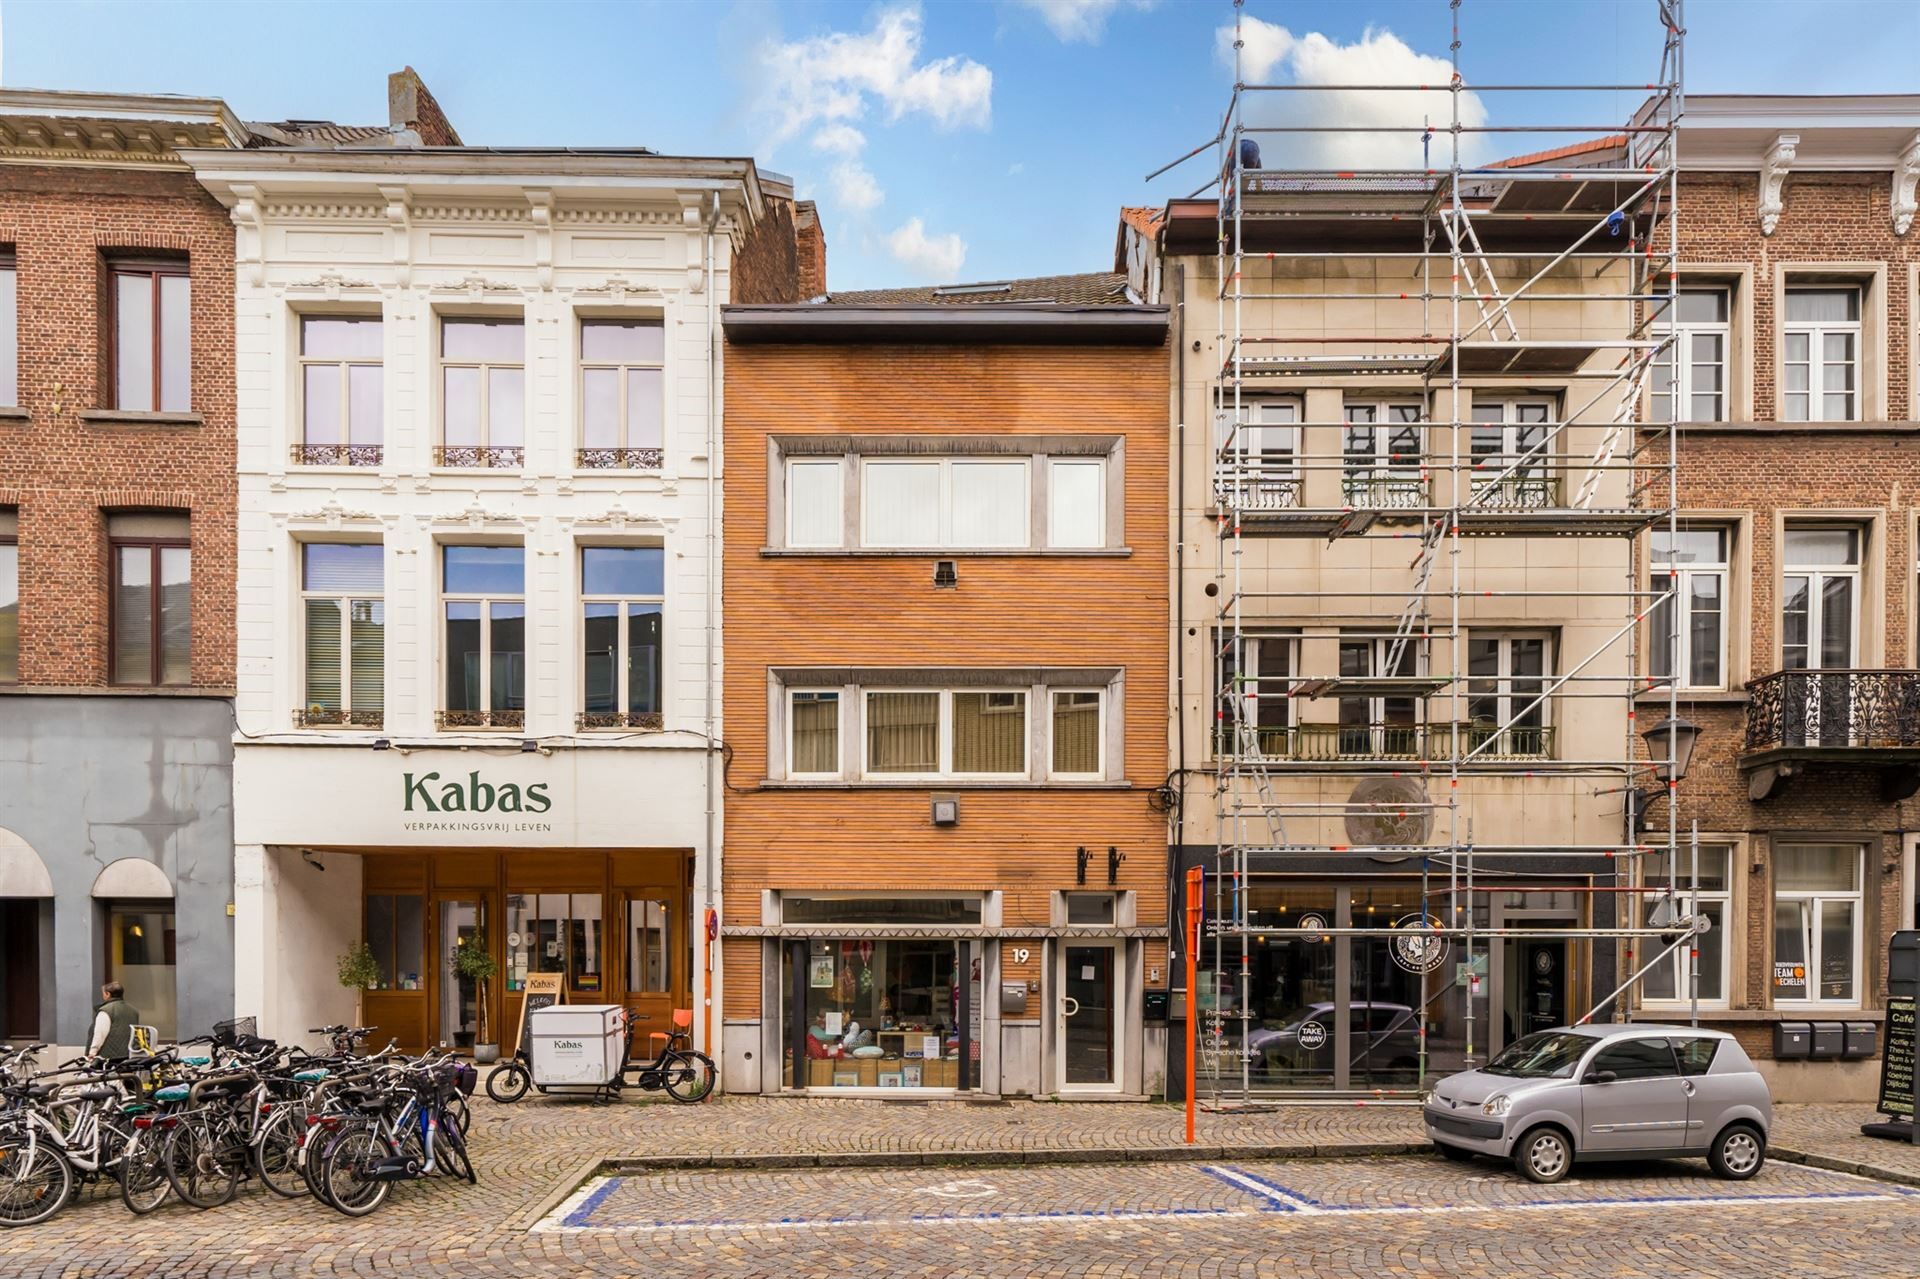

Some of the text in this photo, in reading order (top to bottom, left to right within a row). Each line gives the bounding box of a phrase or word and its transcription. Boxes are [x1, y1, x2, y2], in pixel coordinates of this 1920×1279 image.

[403, 770, 552, 813] Kabas
[404, 823, 551, 832] VERPAKKINGSVRIJ LEVEN
[1012, 948, 1029, 963] 19
[530, 979, 556, 989] Kabas
[1892, 1013, 1914, 1024] Café
[554, 1040, 583, 1049] Kabas
